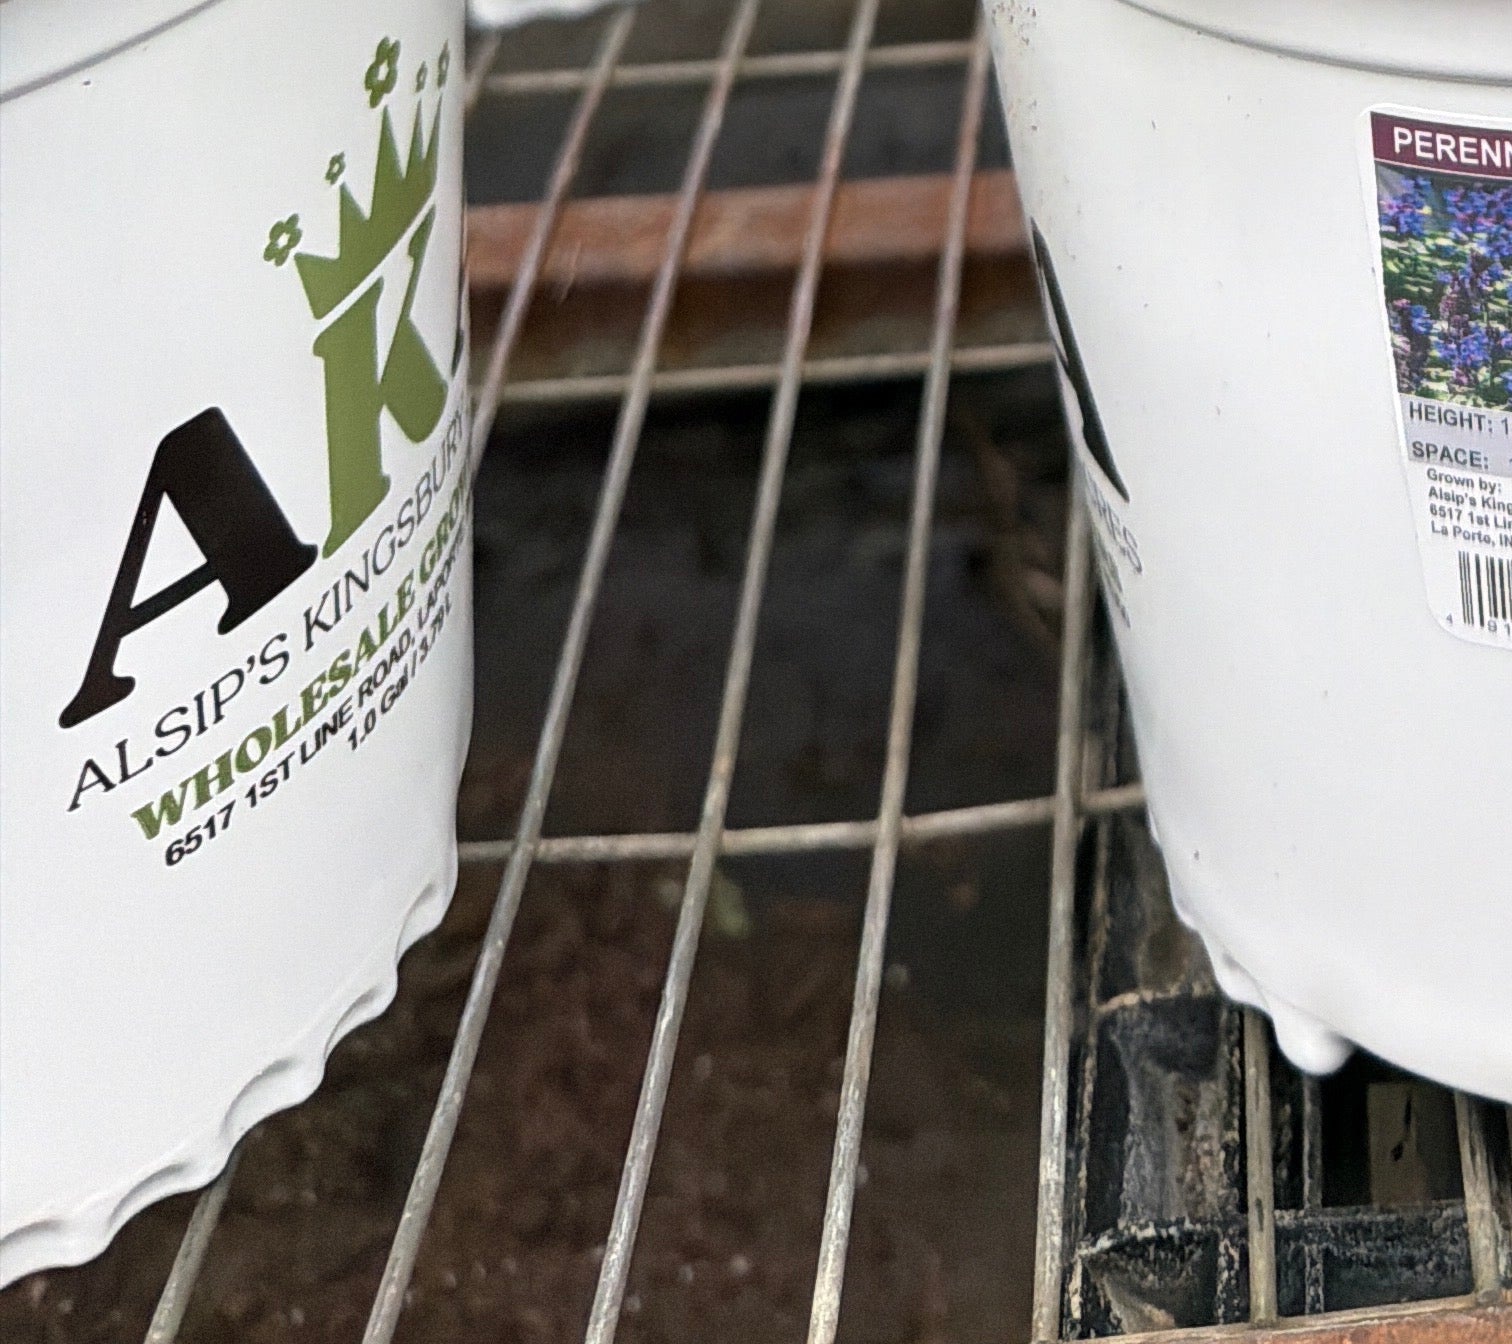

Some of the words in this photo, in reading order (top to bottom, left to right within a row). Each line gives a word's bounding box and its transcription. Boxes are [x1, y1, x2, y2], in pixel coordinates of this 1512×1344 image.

[1409, 401, 1493, 433] HEIGHT:
[58, 202, 463, 729] AK
[1411, 440, 1489, 470] SPACE:
[1426, 468, 1475, 489] Grown
[1478, 476, 1502, 495] by:
[1428, 486, 1477, 508] Alsip's
[1429, 503, 1462, 521] 6517
[1468, 511, 1490, 527] 1st
[1431, 520, 1449, 537] La
[1452, 525, 1496, 547] Porte,
[130, 569, 416, 840] WHOLESALE
[347, 712, 377, 751] 1.0
[379, 665, 409, 715] Gal
[67, 632, 290, 812] ALSIP'S
[164, 799, 236, 867] 6517
[245, 751, 295, 809] 1ST
[299, 694, 354, 767] LINE
[357, 628, 415, 708] ROAD,
